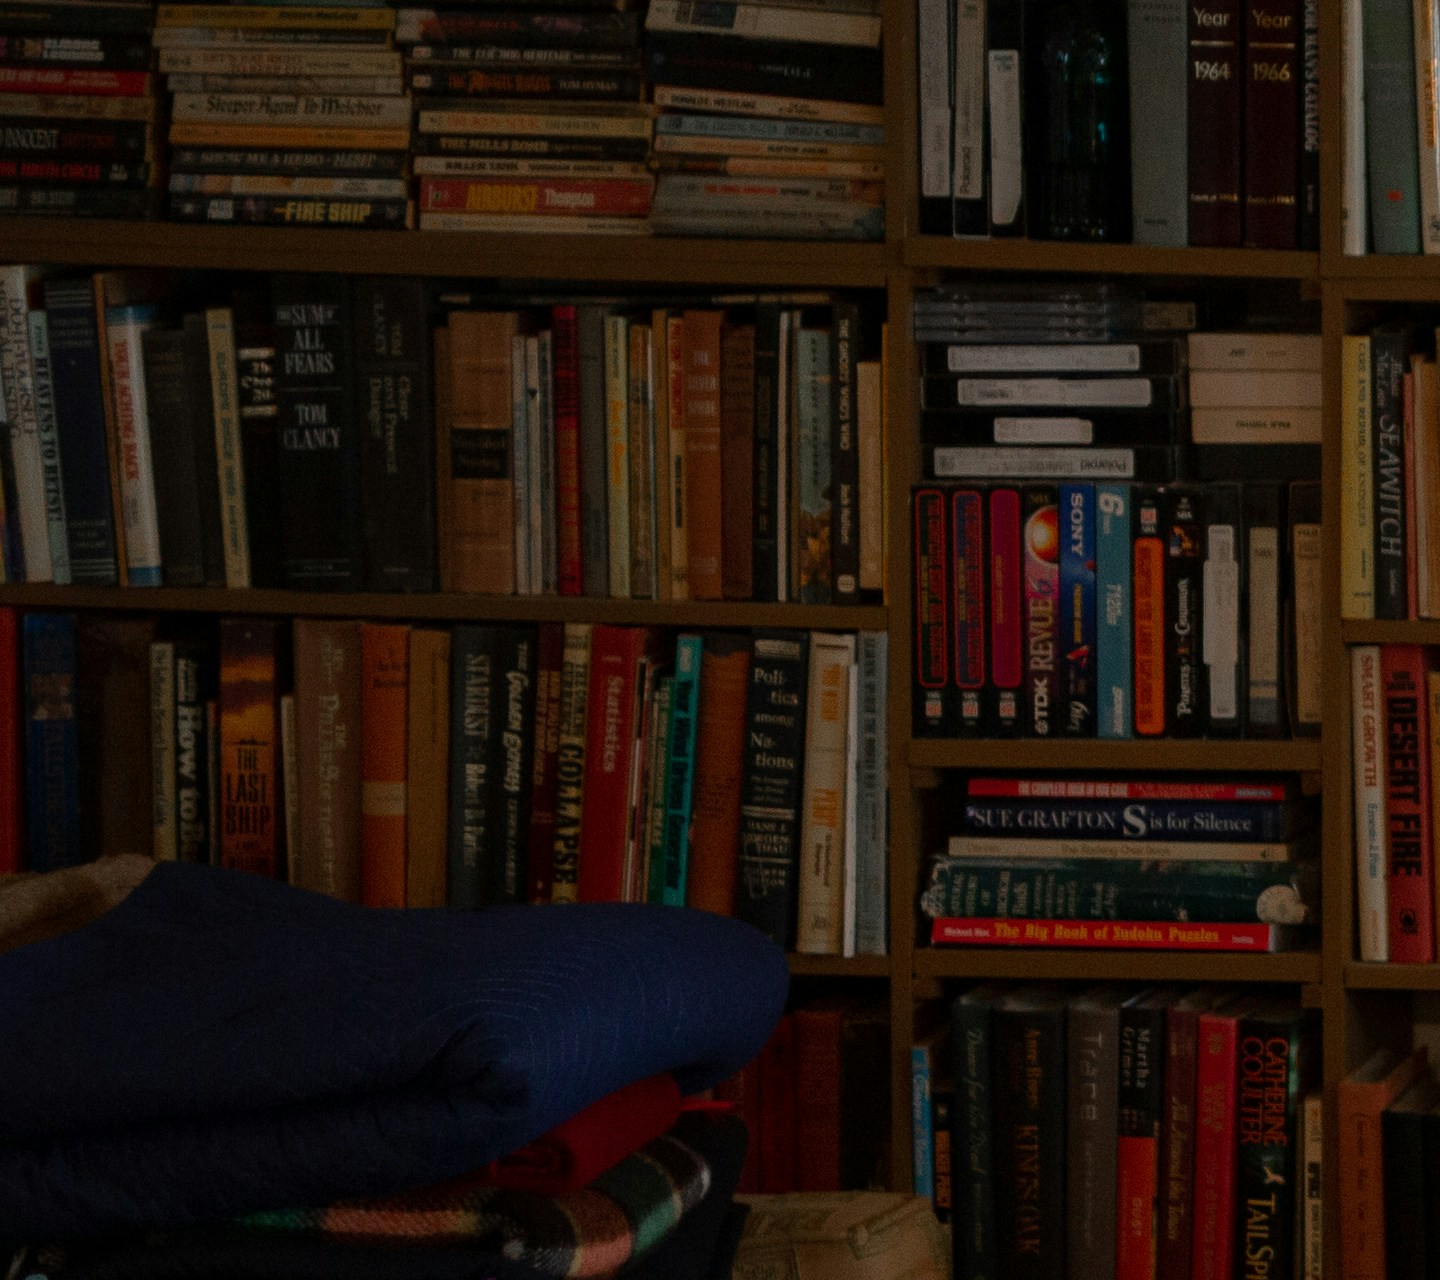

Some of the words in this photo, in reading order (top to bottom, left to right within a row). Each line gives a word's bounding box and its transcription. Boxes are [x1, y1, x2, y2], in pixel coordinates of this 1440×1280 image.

[1193, 10, 1230, 27] Year
[1252, 11, 1291, 28] Year
[1195, 62, 1231, 80] 1964
[1252, 62, 1290, 81] 1966
[294, 329, 324, 351] ALL
[284, 353, 336, 376] FEARS
[294, 404, 327, 426] TOM
[283, 426, 341, 450] CLANCY
[1377, 418, 1402, 556] SEAWITCH
[1071, 492, 1084, 555] SONY
[1030, 596, 1056, 673] REVUE
[1032, 683, 1050, 734] TDK
[226, 777, 268, 801] LAST
[225, 804, 270, 833] SHIP
[973, 810, 1010, 828] SUE
[1016, 810, 1115, 830] GRAFTON
[1123, 804, 1147, 837] S
[1149, 811, 1162, 829] is
[1163, 813, 1189, 830] for
[1193, 813, 1253, 832] Silence
[995, 923, 1021, 938] The
[1025, 924, 1047, 940] Big
[1054, 925, 1089, 940] Book
[1093, 925, 1108, 940] of
[1112, 927, 1163, 942] Sudoku
[1168, 927, 1219, 943] Puzzles
[1238, 1037, 1264, 1145] COULTER
[1263, 1037, 1289, 1146] CATHERINE
